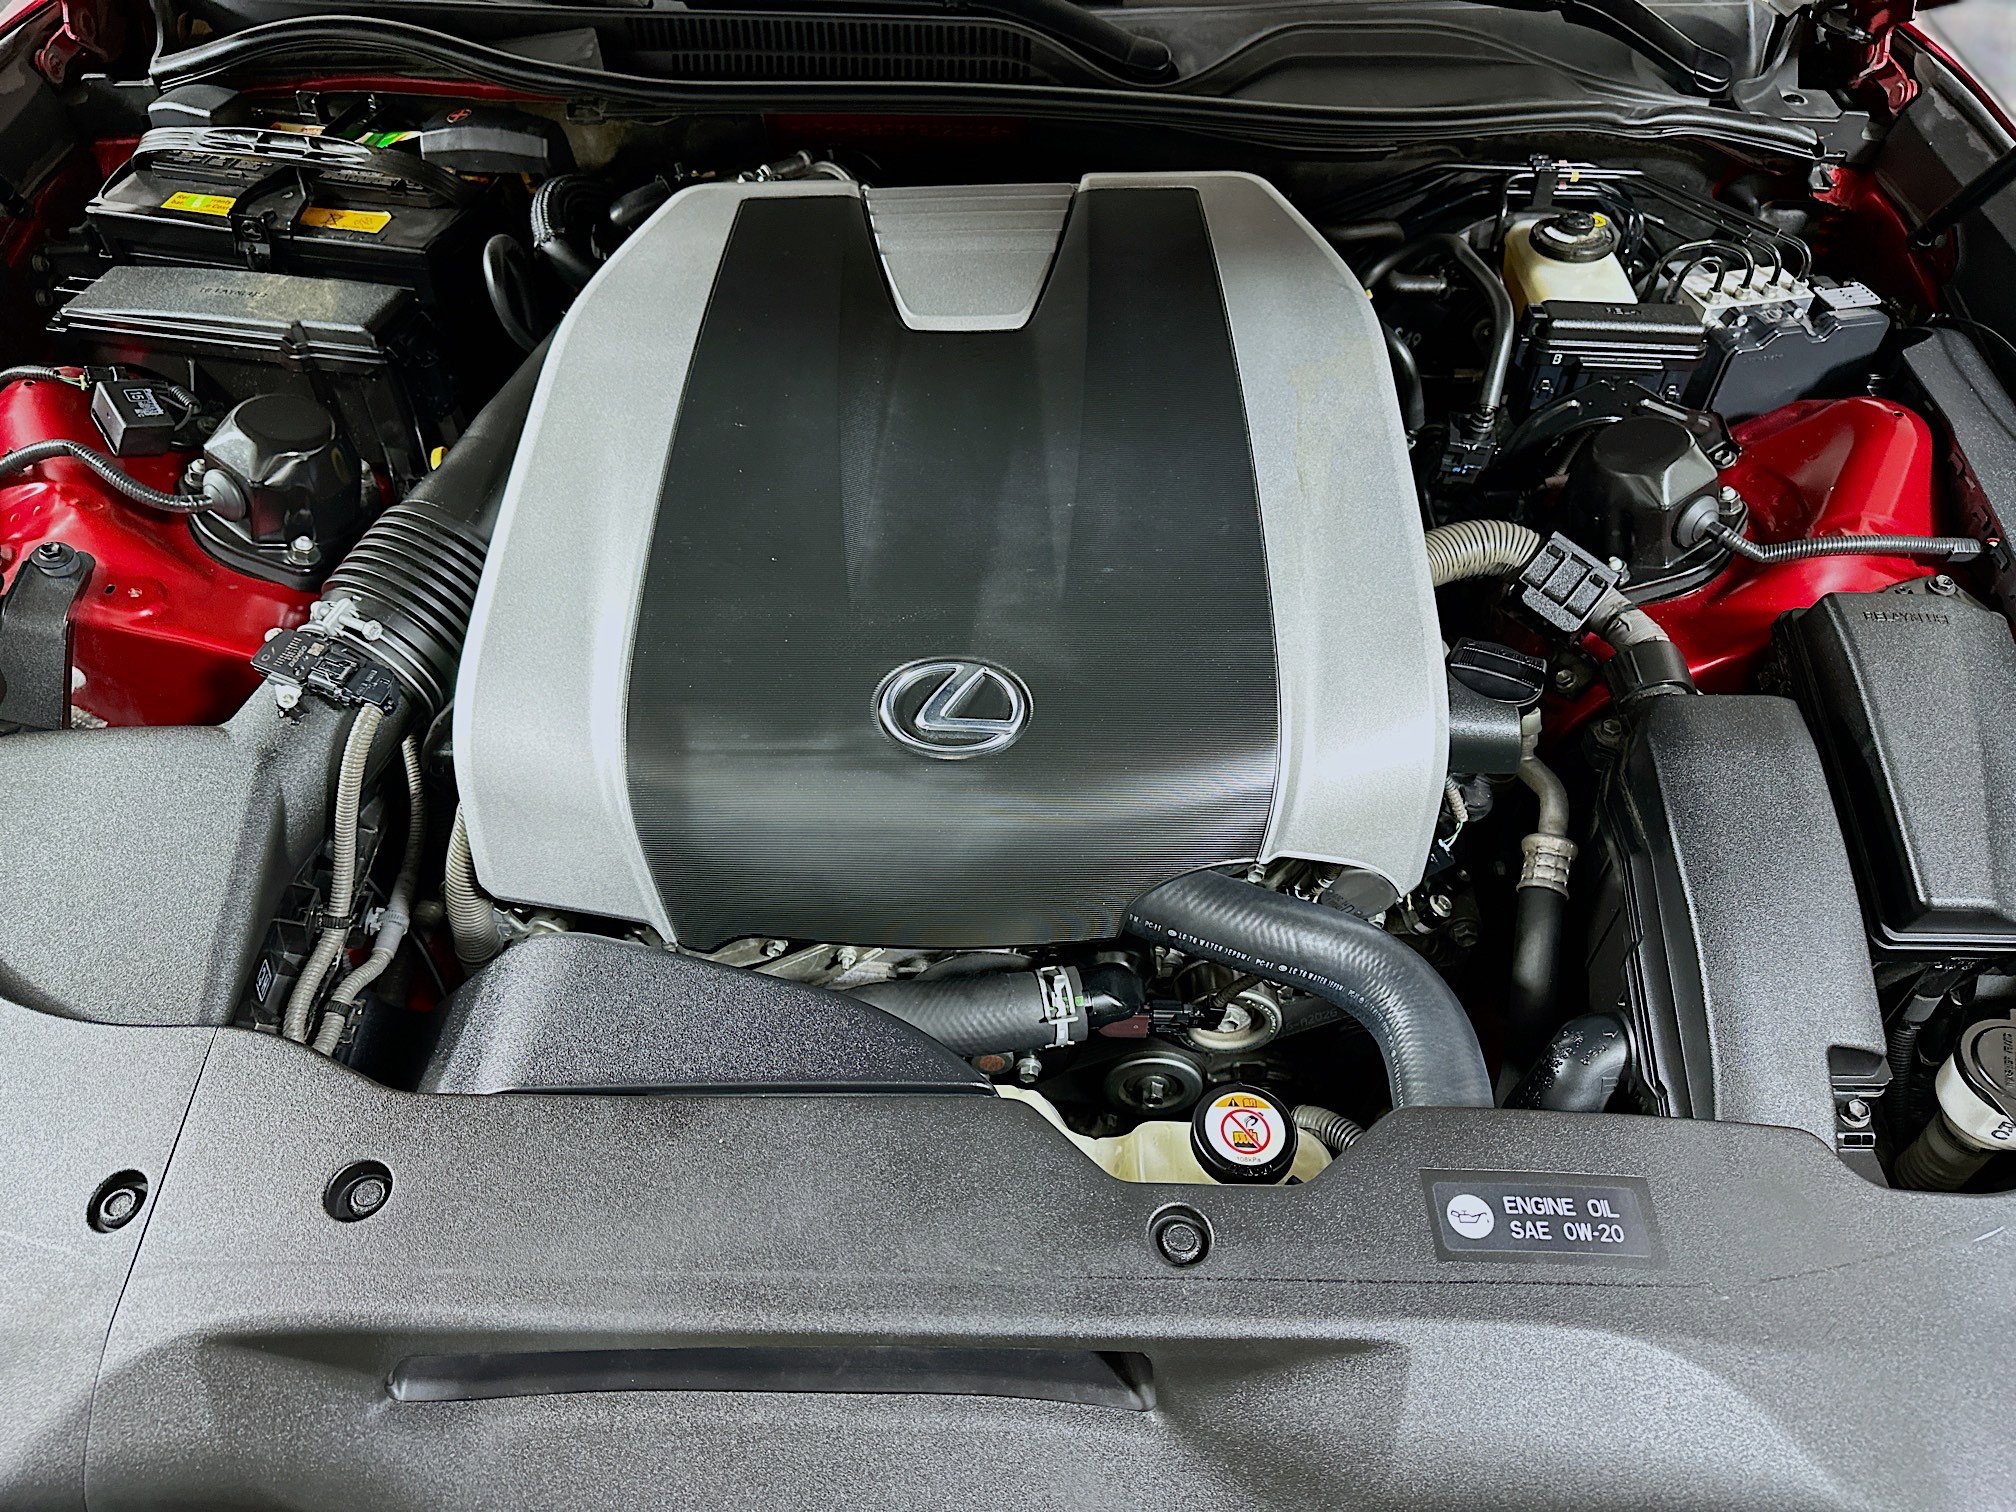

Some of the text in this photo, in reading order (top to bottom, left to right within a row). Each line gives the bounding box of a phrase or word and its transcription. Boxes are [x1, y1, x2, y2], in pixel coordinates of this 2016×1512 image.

[1502, 1195, 1620, 1219] ENGINE OIL
[1509, 1221, 1625, 1244] SAE 0W-20
